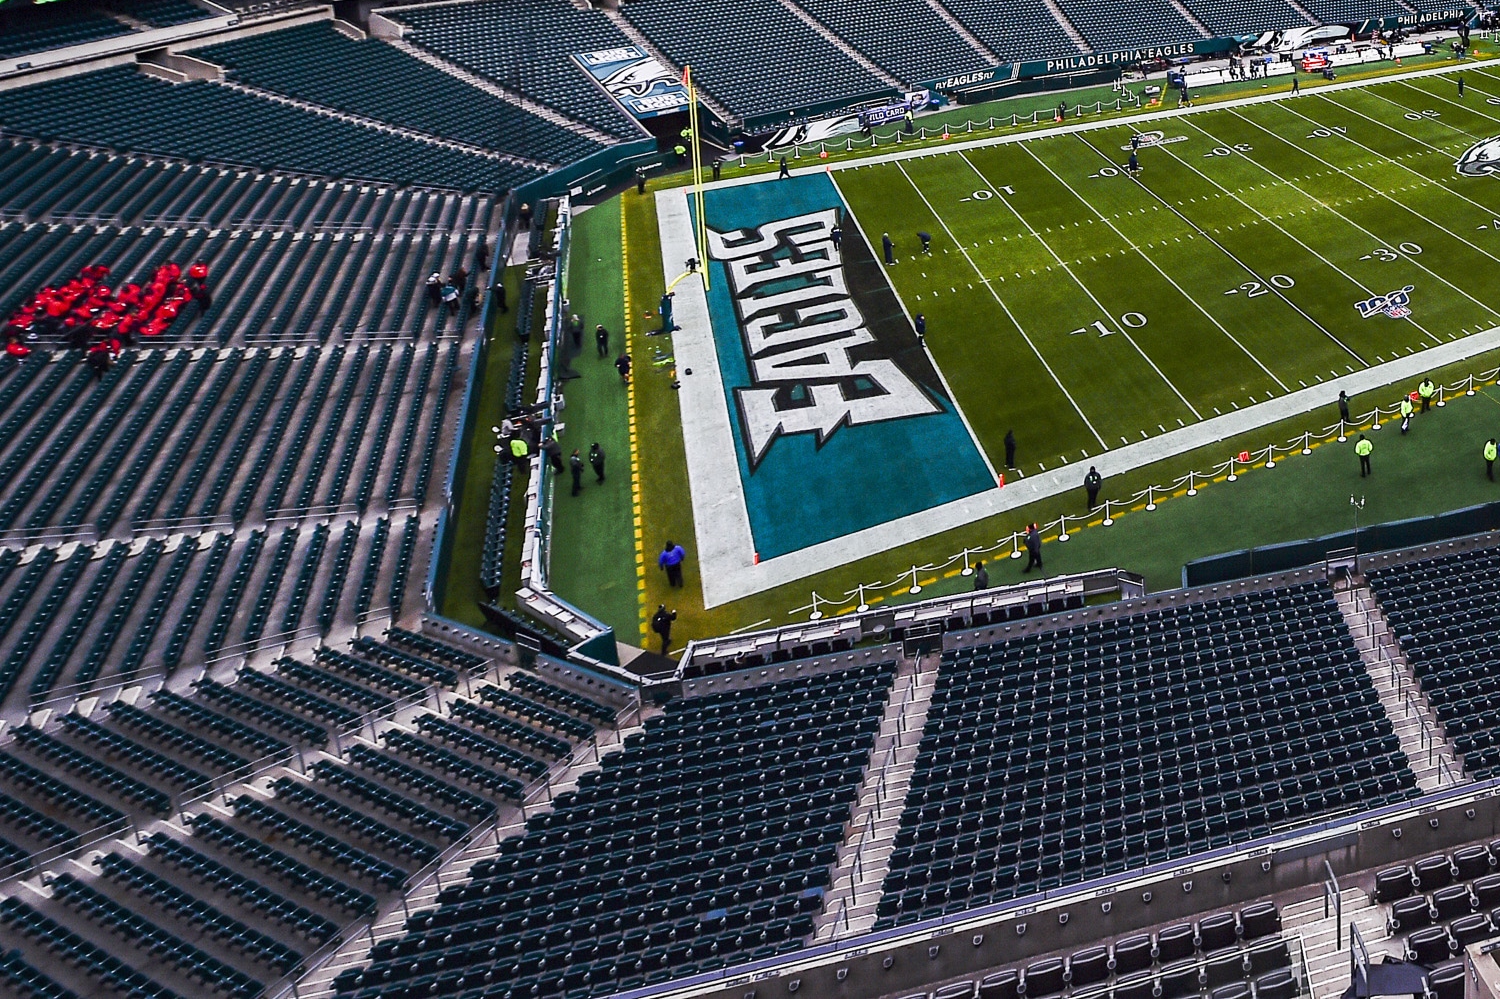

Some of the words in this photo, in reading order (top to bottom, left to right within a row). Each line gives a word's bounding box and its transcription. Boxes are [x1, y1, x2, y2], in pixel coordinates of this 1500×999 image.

[1047, 50, 1142, 72] PHILADELPHIA
[1149, 43, 1194, 58] EAGLES
[886, 107, 905, 117] CARD
[1404, 109, 1440, 121] 50
[1212, 142, 1253, 157] 30
[972, 184, 1016, 201] 10
[1372, 242, 1423, 262] 30
[1239, 274, 1295, 299] 20
[1090, 311, 1148, 338] 10
[705, 207, 946, 472] EAGLES
